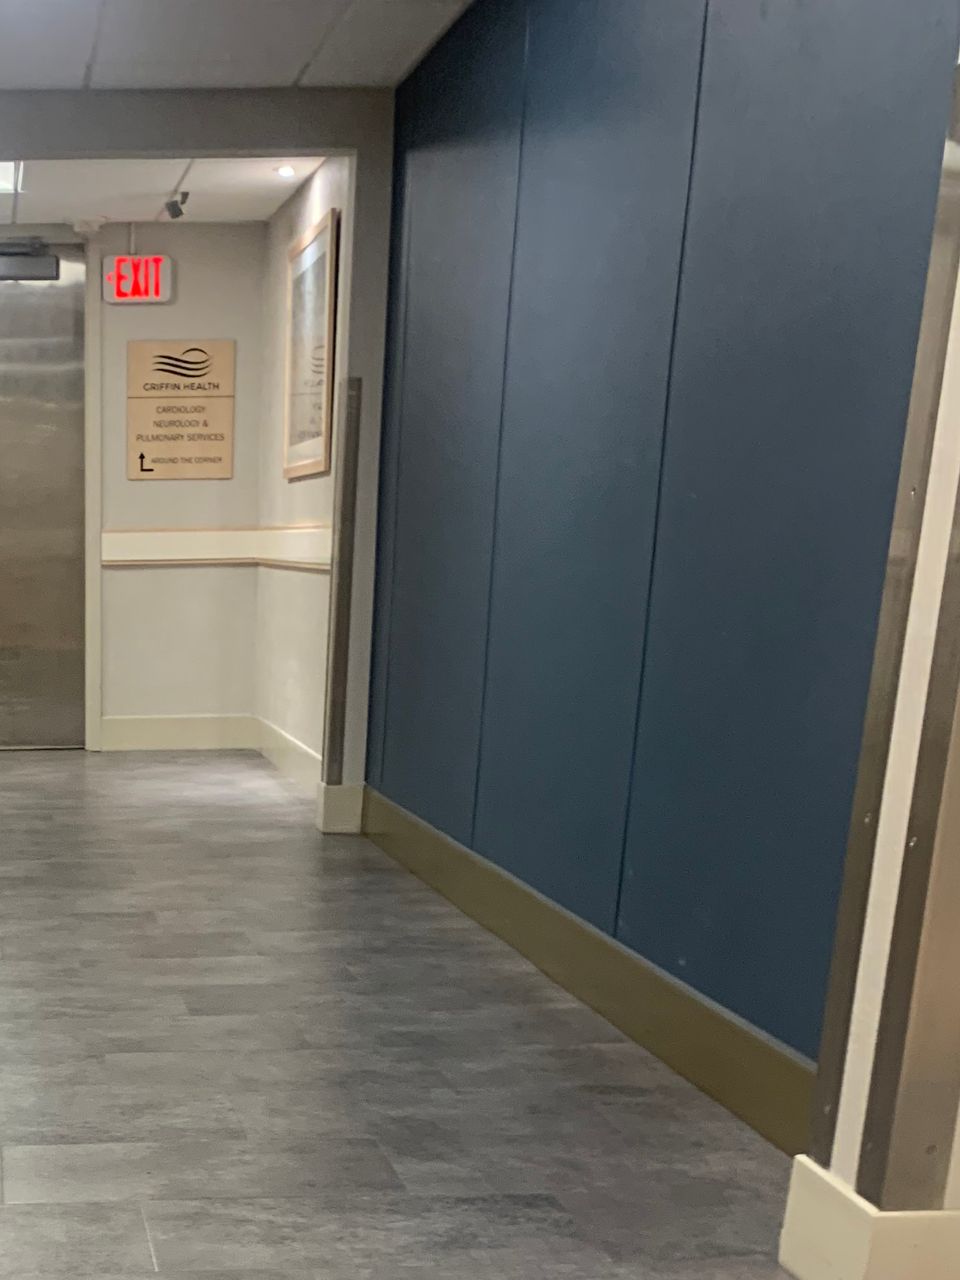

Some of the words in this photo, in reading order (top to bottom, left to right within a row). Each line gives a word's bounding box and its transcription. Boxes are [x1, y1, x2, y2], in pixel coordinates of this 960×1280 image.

[115, 256, 163, 298] EXIT
[143, 382, 181, 391] GRIFFIN
[183, 382, 220, 391] HEALTH
[156, 405, 206, 414] CARDIOLOGY
[153, 420, 200, 428] NEUROLOGY
[202, 420, 209, 428] &
[136, 434, 184, 442] PULMONARY
[187, 433, 225, 442] SERVICES
[194, 456, 222, 464] CORNER
